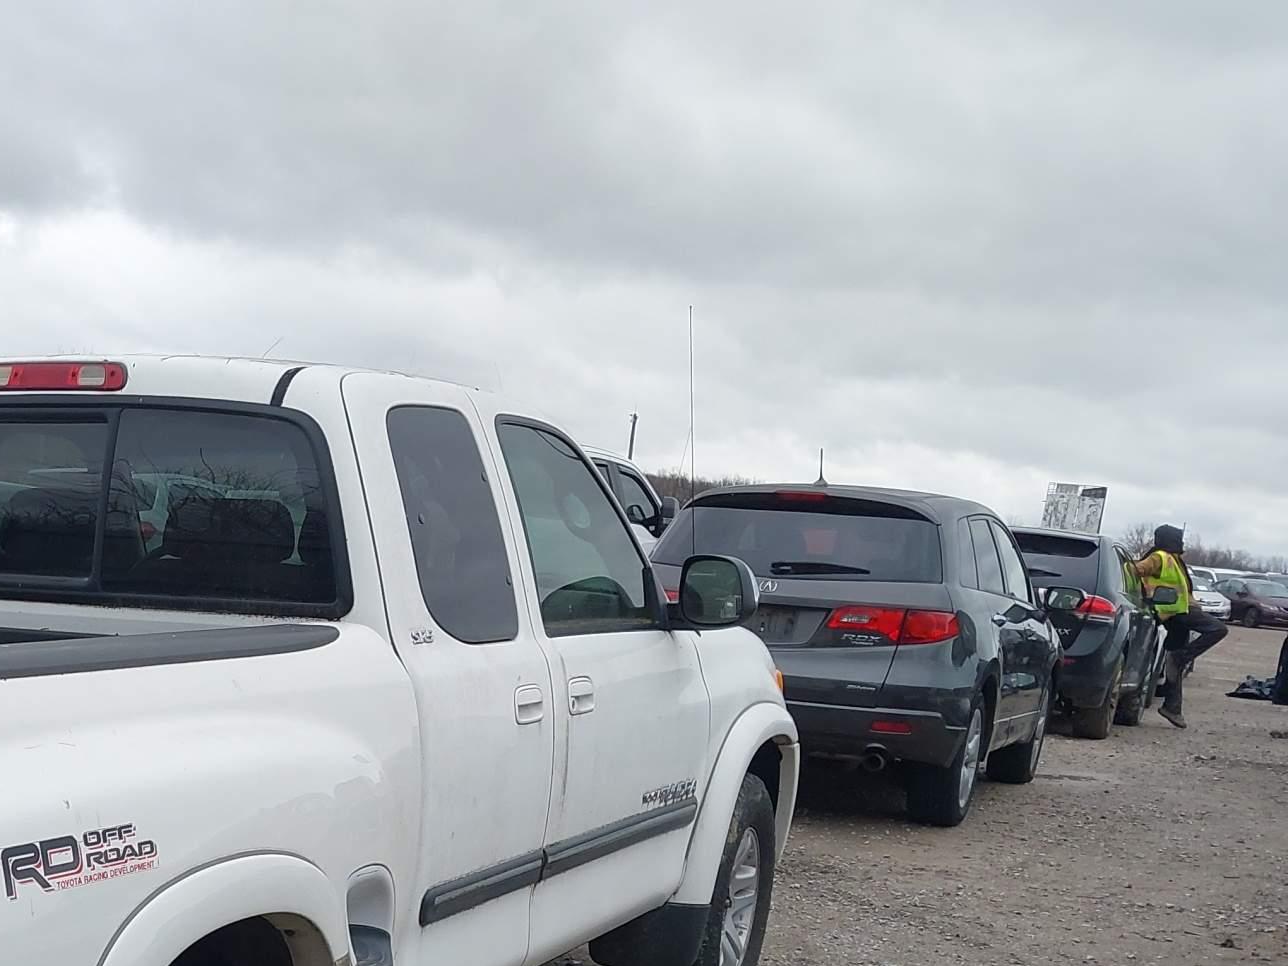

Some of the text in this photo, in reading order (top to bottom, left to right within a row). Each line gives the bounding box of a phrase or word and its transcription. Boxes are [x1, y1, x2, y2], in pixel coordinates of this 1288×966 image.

[82, 823, 136, 849] OFF
[85, 840, 158, 870] ROAD
[56, 861, 155, 889] TOYOTA RACING DEVELOPMENT
